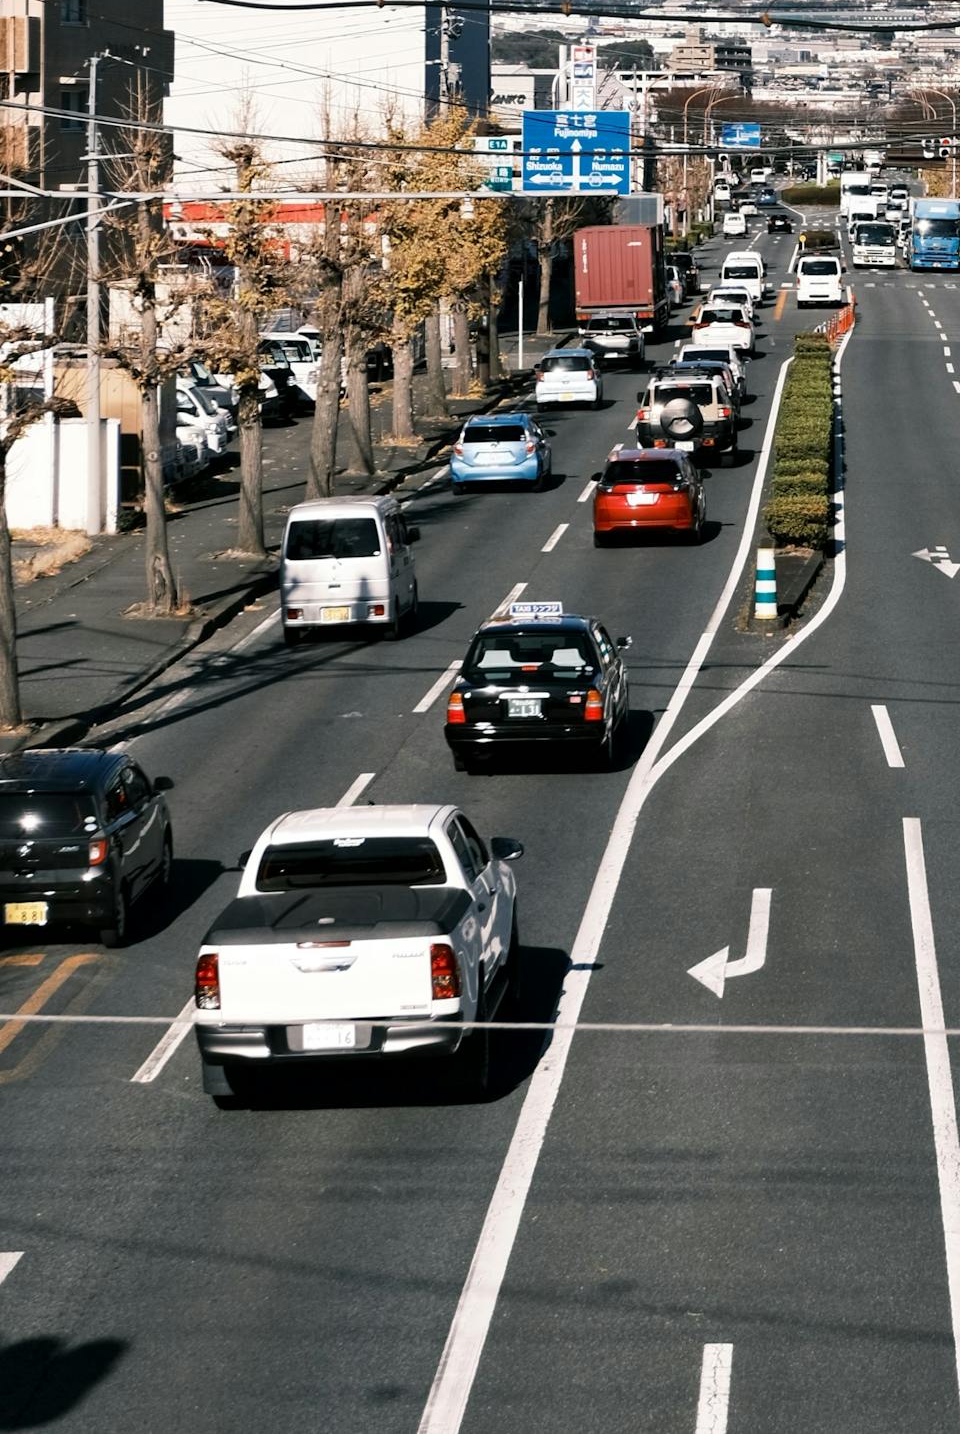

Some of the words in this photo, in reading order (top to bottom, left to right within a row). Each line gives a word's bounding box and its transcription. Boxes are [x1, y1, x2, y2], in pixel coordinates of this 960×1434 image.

[555, 114, 597, 127] 富士宮
[553, 127, 598, 139] Fujinomiya
[489, 140, 507, 149] E1A
[525, 161, 563, 171] Shizuoka
[591, 161, 625, 171] Numazu
